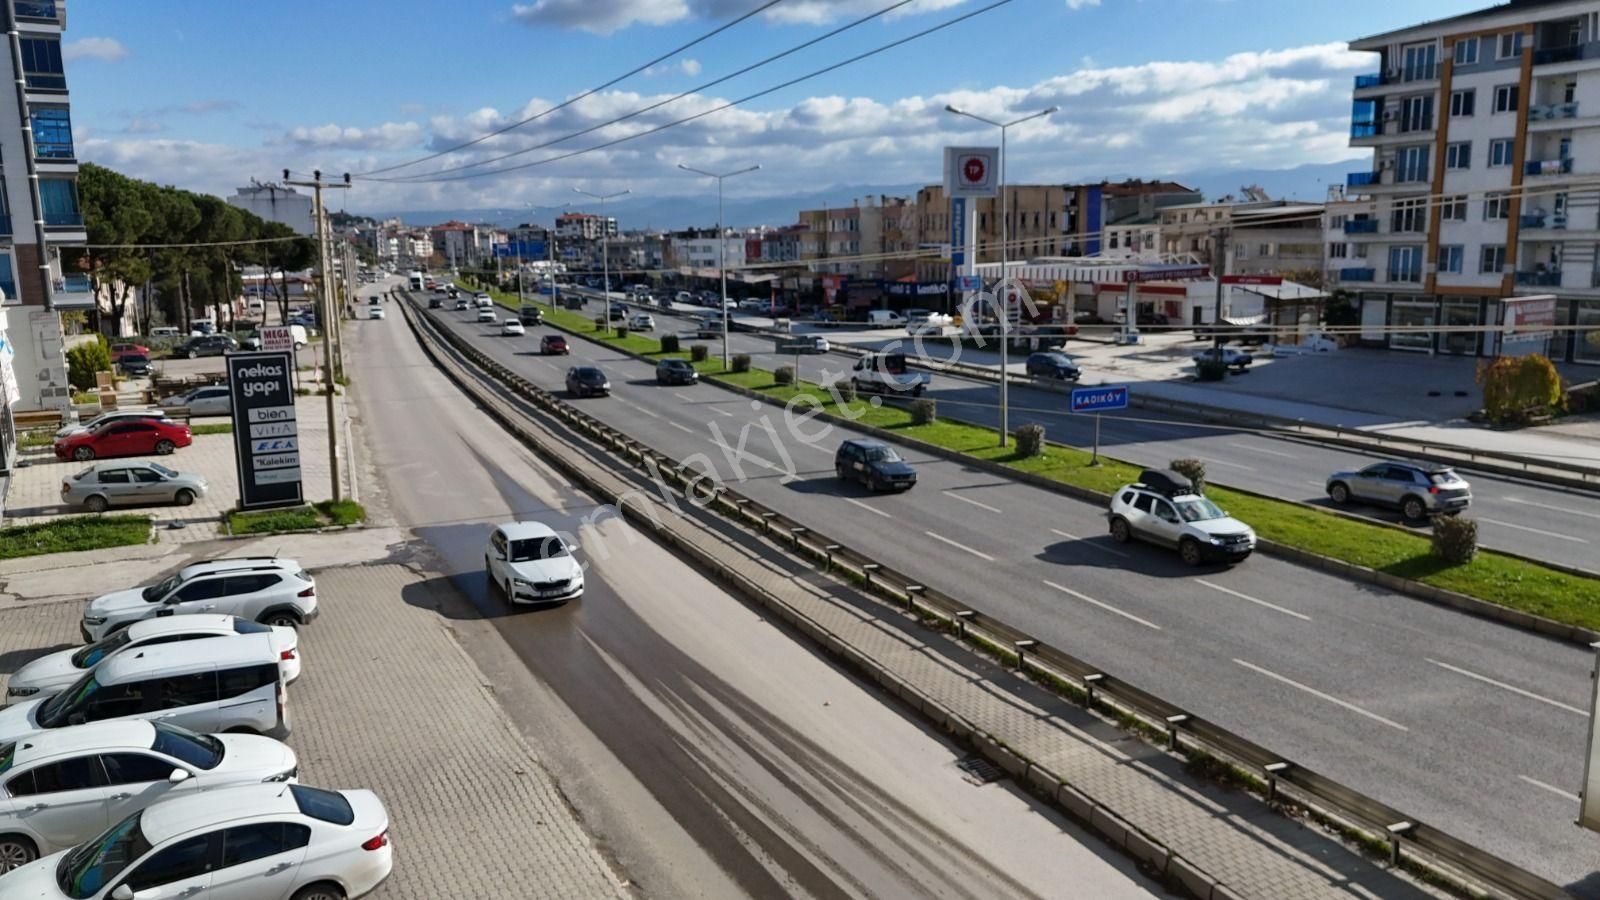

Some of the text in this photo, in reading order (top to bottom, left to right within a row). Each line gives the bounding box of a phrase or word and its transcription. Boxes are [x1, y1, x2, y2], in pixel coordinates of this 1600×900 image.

[969, 165, 980, 175] TP
[263, 329, 290, 339] MEGA
[238, 363, 283, 379] nekas
[243, 381, 280, 397] yapı
[1076, 392, 1121, 404] KADIKÖY
[257, 409, 288, 420] bien
